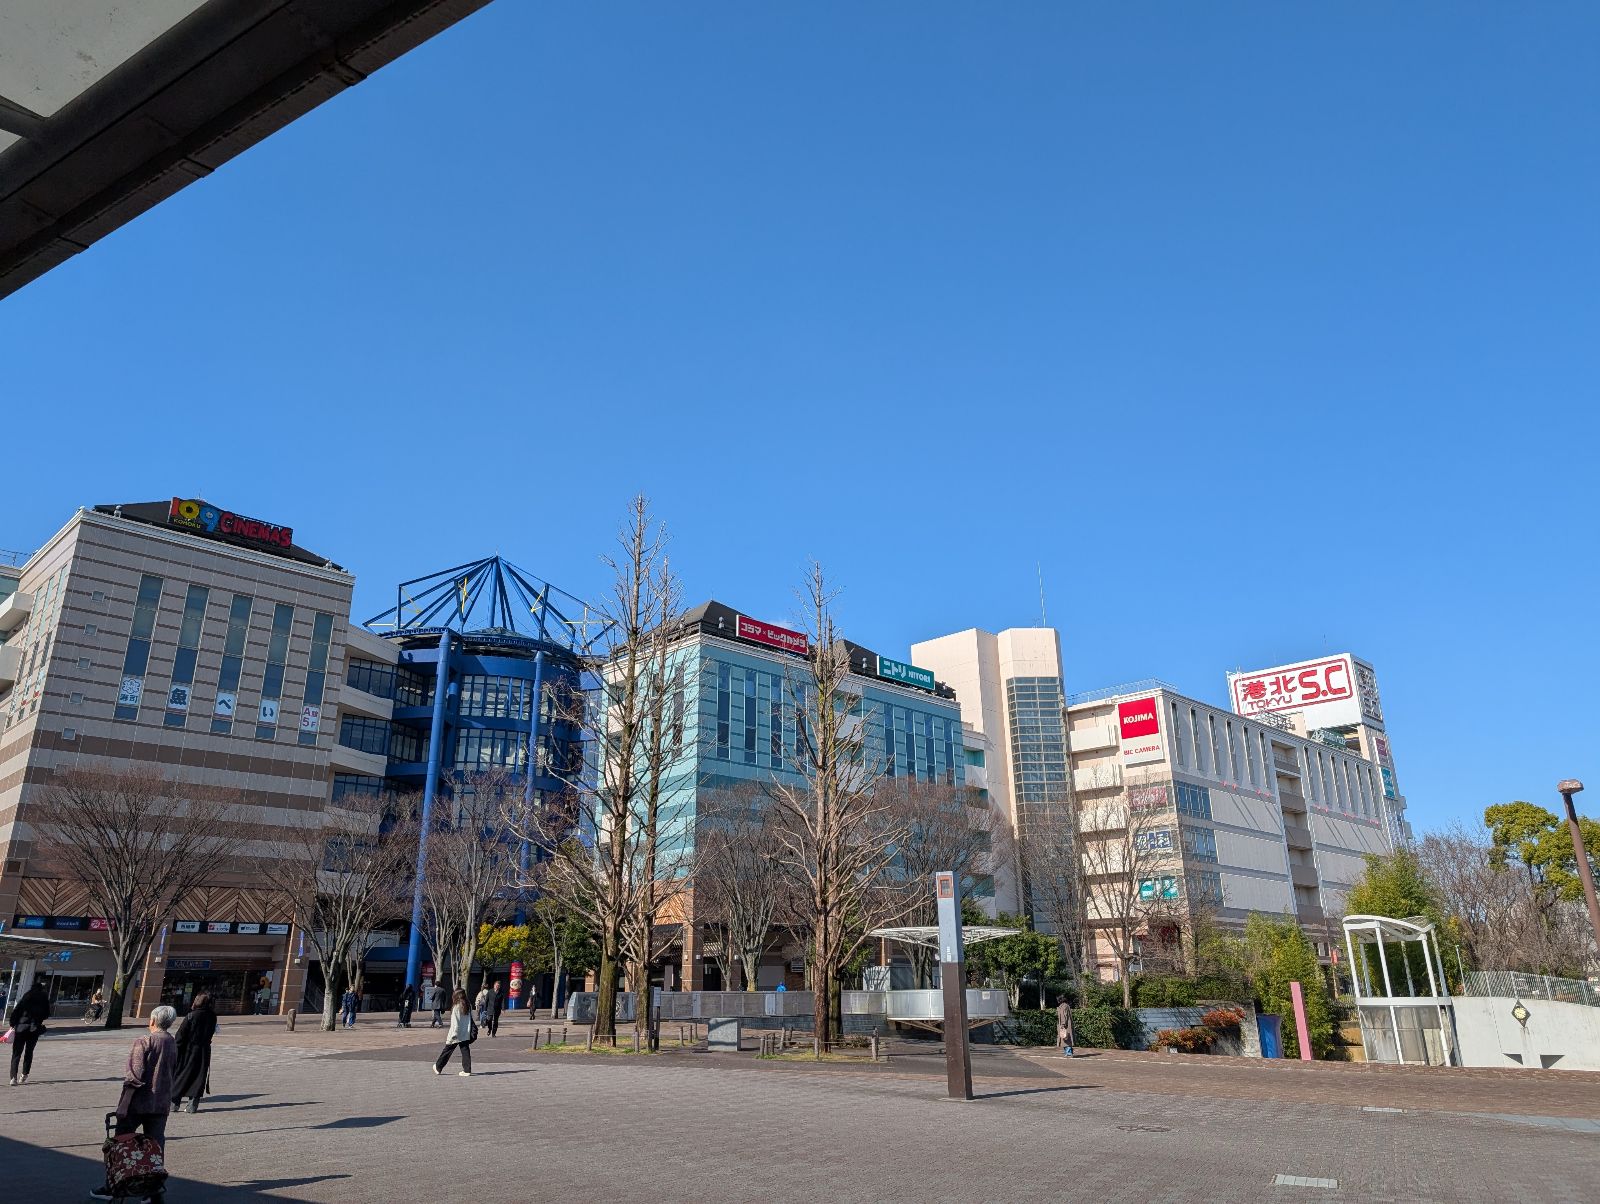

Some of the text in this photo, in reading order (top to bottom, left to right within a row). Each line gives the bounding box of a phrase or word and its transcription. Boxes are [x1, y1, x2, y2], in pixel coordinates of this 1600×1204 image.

[171, 497, 292, 547] 109 CINEMAS
[173, 517, 201, 529] KOHOKU
[883, 660, 931, 684] ニトリ NITORI
[1247, 694, 1293, 711] TOKYU
[1123, 712, 1154, 725] KOJIMA
[1134, 744, 1161, 754] CAMERA
